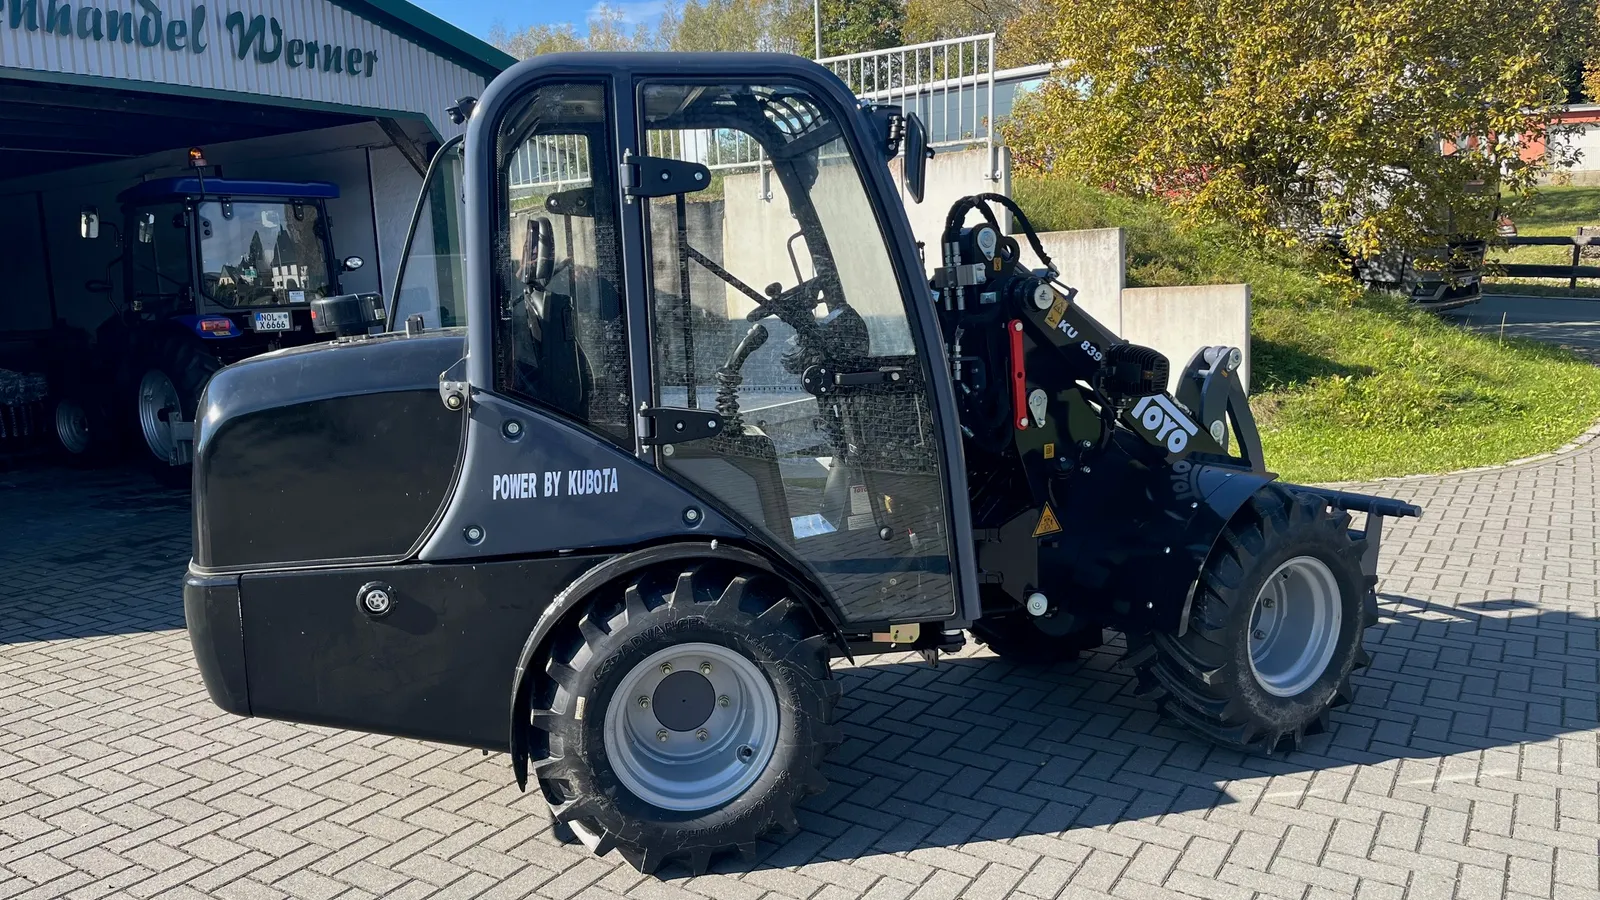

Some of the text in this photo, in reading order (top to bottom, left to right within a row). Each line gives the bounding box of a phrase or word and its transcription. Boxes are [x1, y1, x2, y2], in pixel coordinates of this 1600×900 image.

[0, 0, 379, 77] nhandel Werner
[261, 313, 277, 322] NOL
[1057, 319, 1103, 362] KU 839
[1131, 393, 1199, 454] TOYO
[492, 467, 619, 501] POWER BY KUBOTA
[620, 616, 699, 657] ADVANCE
